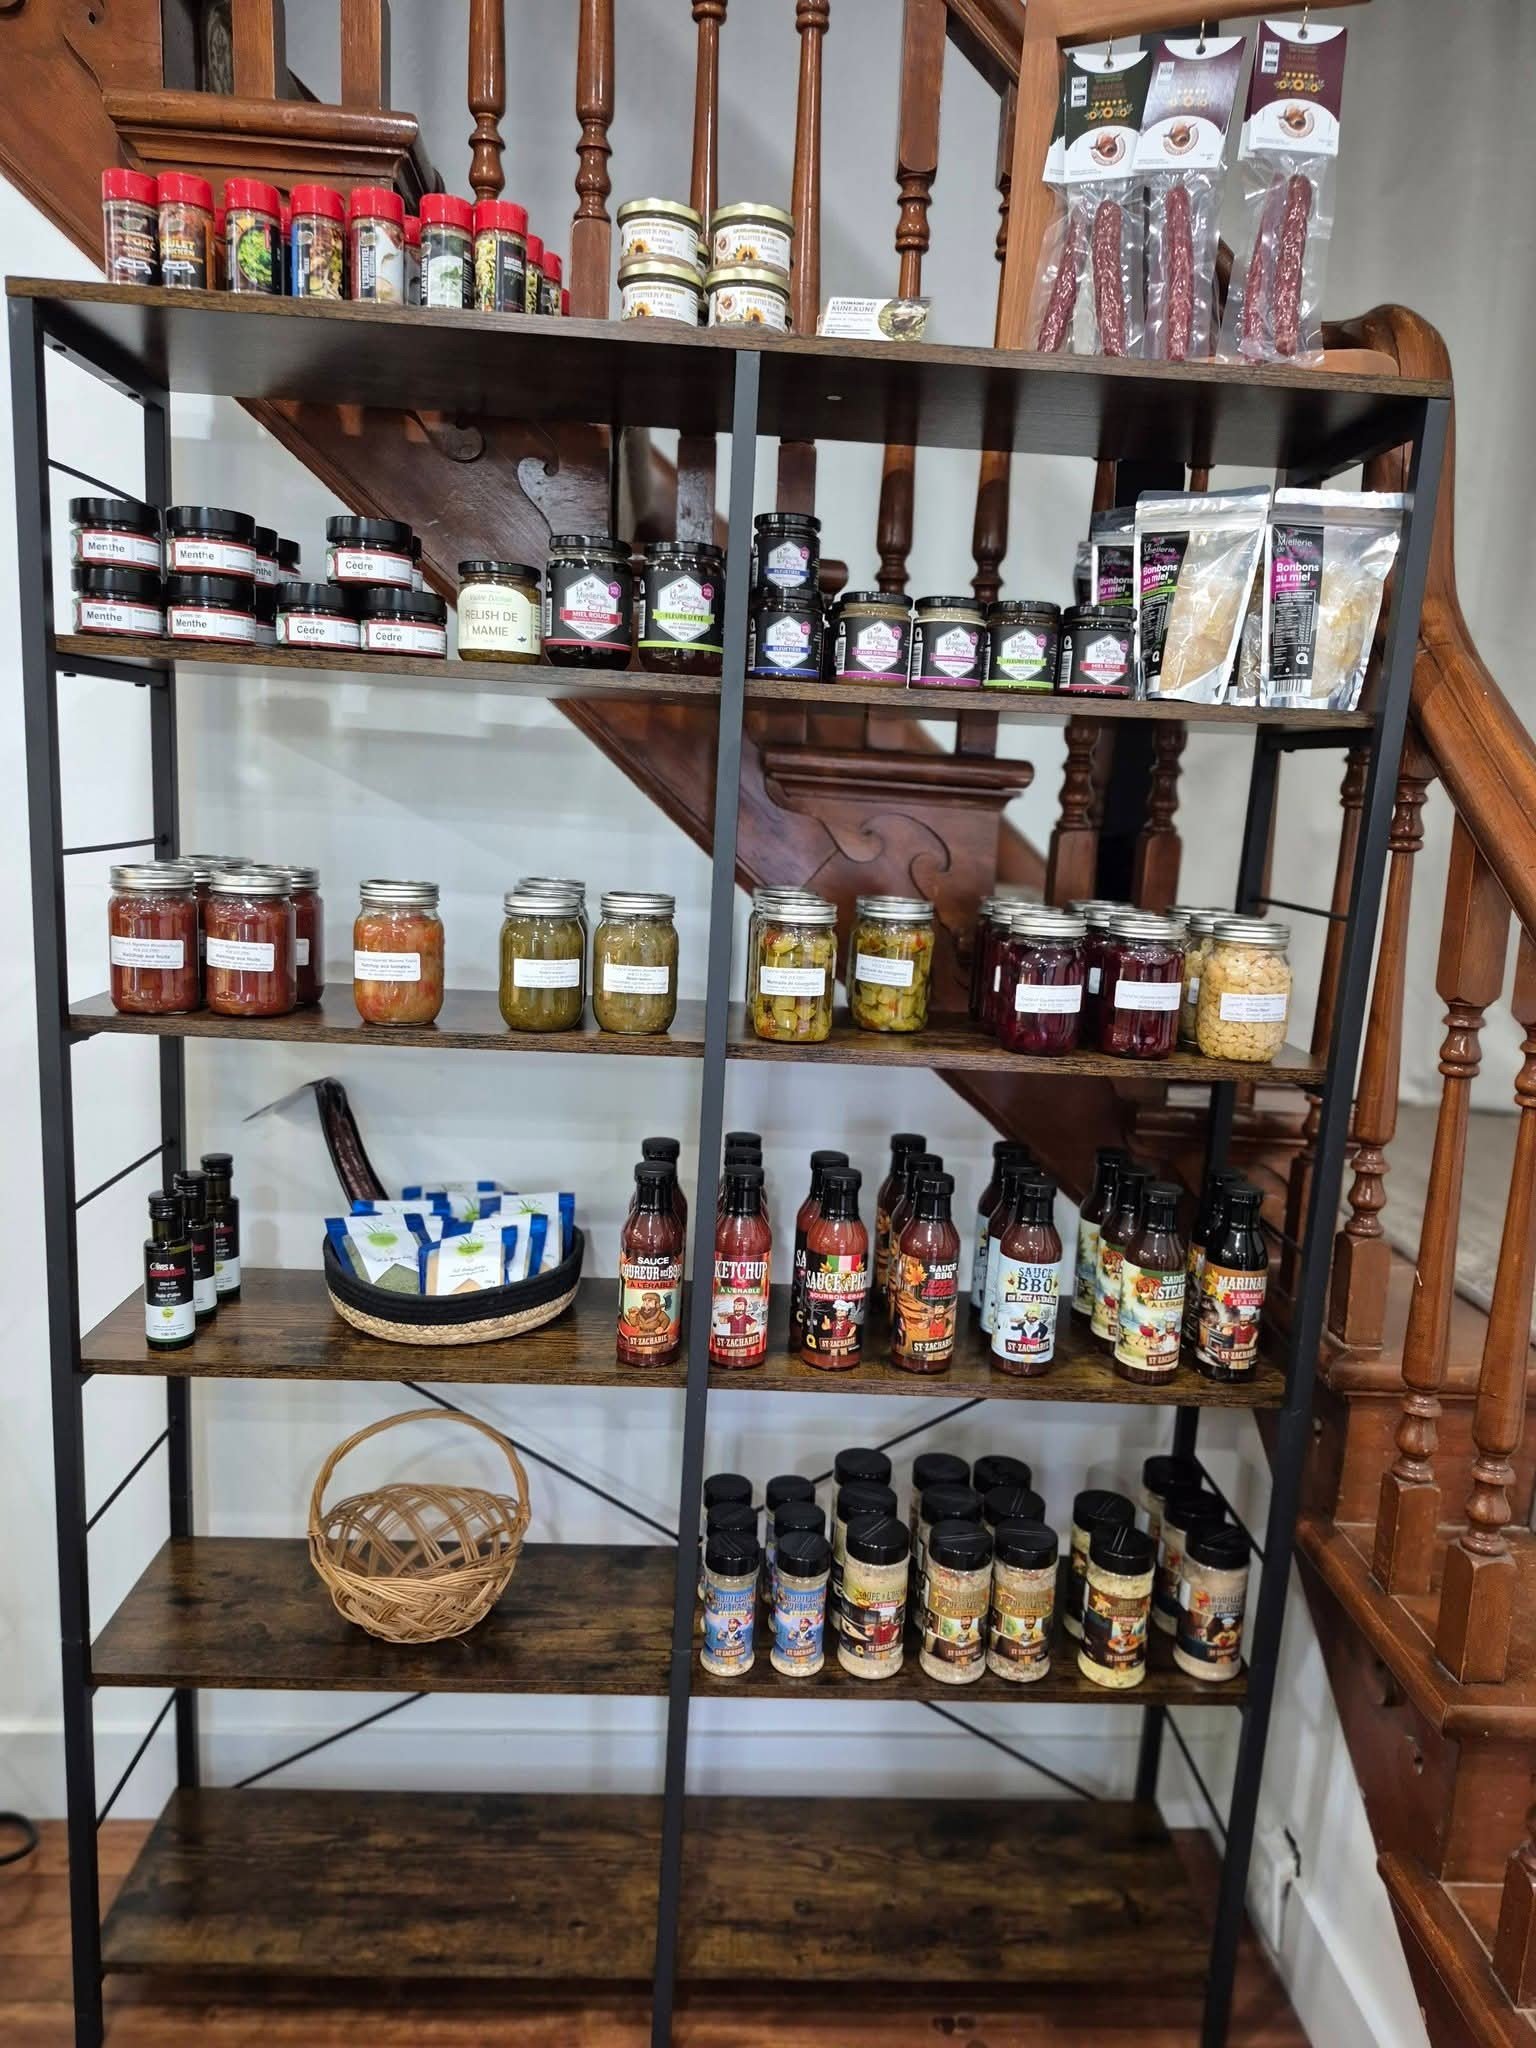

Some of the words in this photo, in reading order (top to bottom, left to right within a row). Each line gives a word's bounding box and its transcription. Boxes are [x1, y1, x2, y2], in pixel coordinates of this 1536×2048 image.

[88, 542, 125, 553] Menthe
[1278, 538, 1313, 547] Miellerie
[180, 550, 215, 560] Menthe
[1144, 547, 1176, 555] Miellerie
[345, 560, 374, 571] Cèdre
[1143, 564, 1178, 576] Bonbons
[1276, 561, 1320, 573] Bonbons
[255, 568, 272, 577] nthe
[1275, 574, 1287, 583] au
[1289, 571, 1311, 582] miel
[1143, 578, 1151, 586] au
[1151, 571, 1169, 582] miel
[1108, 584, 1126, 594] miel
[86, 611, 123, 622] Menthe
[465, 609, 500, 621] RELISH
[502, 611, 519, 623] DE
[572, 610, 588, 618] MIEL
[176, 619, 207, 629] Menthe
[296, 625, 326, 636] Cèdre
[472, 625, 510, 637] MAMIE
[375, 631, 403, 642] Cèdre
[637, 1256, 670, 1266] SAUCE
[714, 1260, 768, 1280] KETCHUP
[929, 1262, 958, 1273] SAUCE
[1018, 1267, 1054, 1279] SAUCE
[806, 1270, 841, 1292] SAUCE
[934, 1271, 953, 1280] BBQ
[1016, 1276, 1053, 1294] BBQ
[629, 1334, 668, 1346] ST-ZACHARIE
[716, 1334, 760, 1347] ST-ZACHARIE
[821, 1336, 856, 1348] ST-ZACHARIE
[859, 1591, 880, 1601] SOUPE
